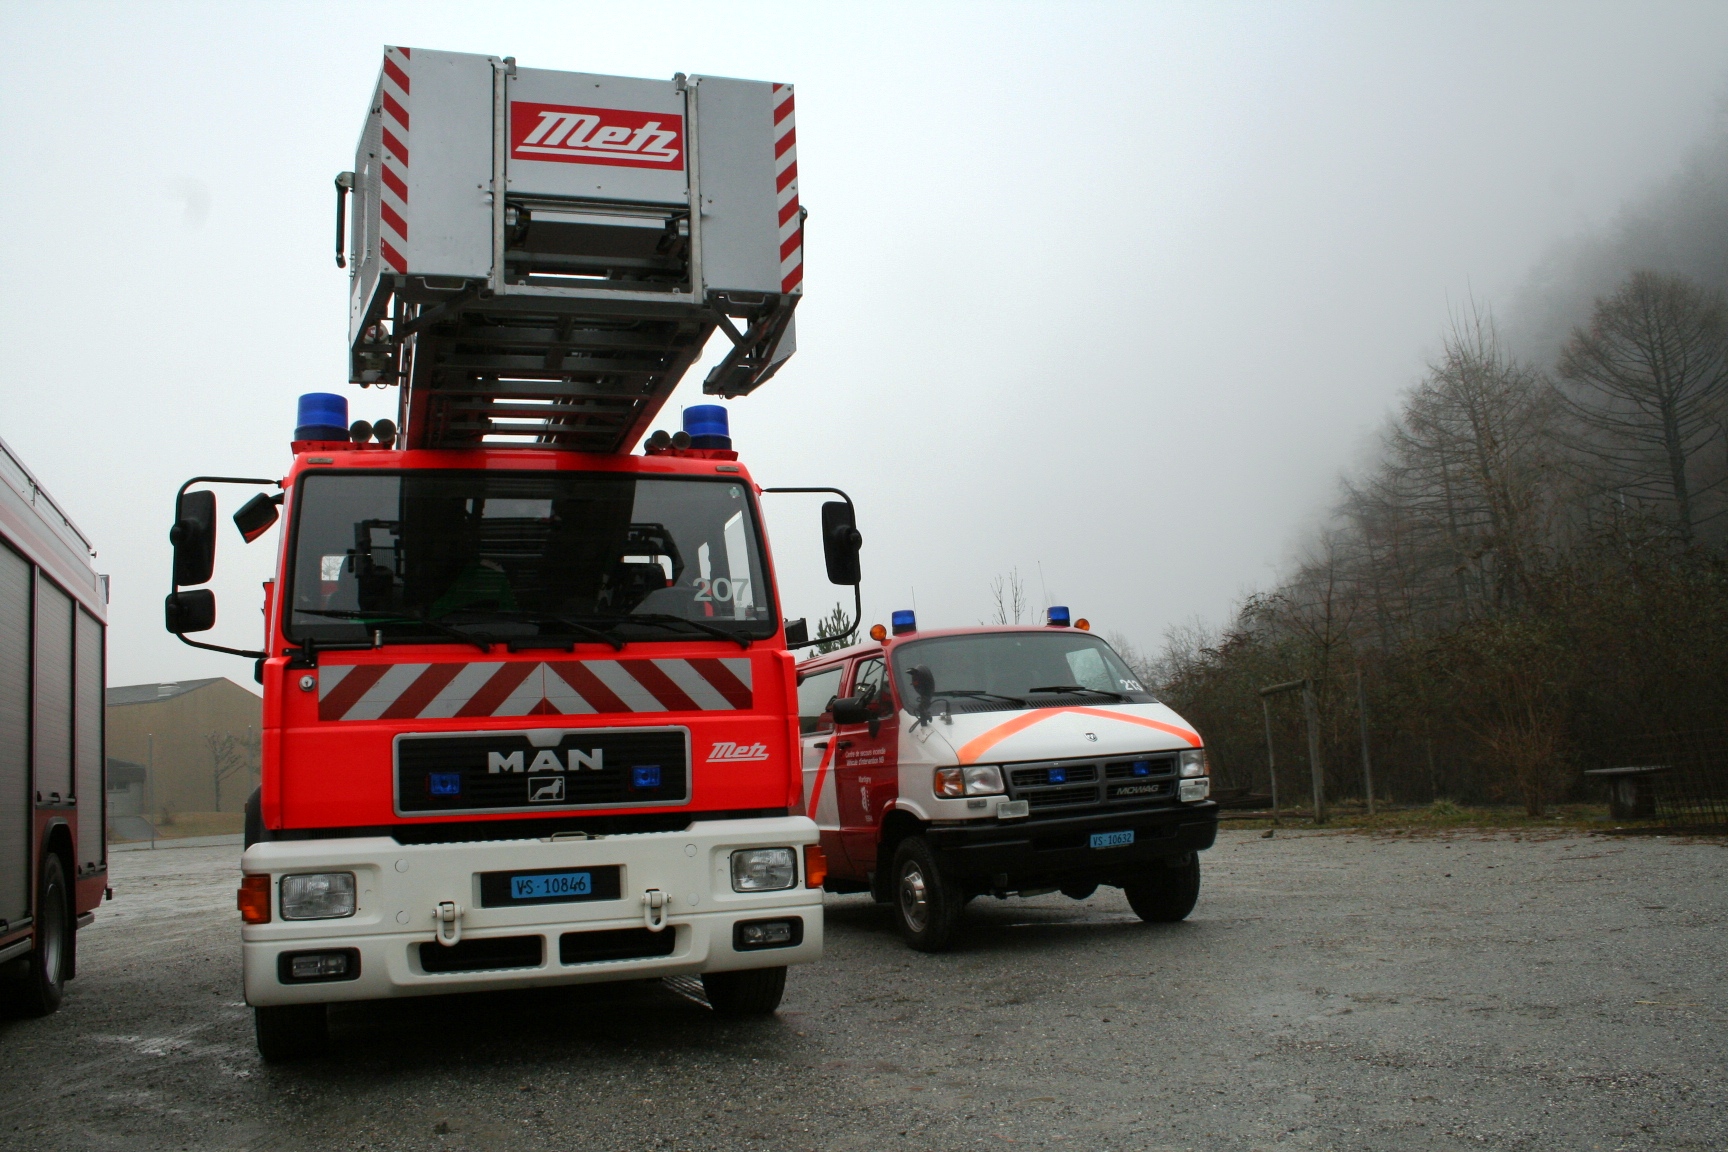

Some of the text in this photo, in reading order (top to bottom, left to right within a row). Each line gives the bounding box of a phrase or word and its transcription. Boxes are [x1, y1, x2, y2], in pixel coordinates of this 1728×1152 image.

[515, 111, 679, 162] Metz
[693, 577, 749, 602] 207
[1120, 679, 1144, 692] 213
[488, 748, 603, 774] MAN
[705, 742, 769, 763] Metz
[1116, 784, 1160, 796] MOWAG
